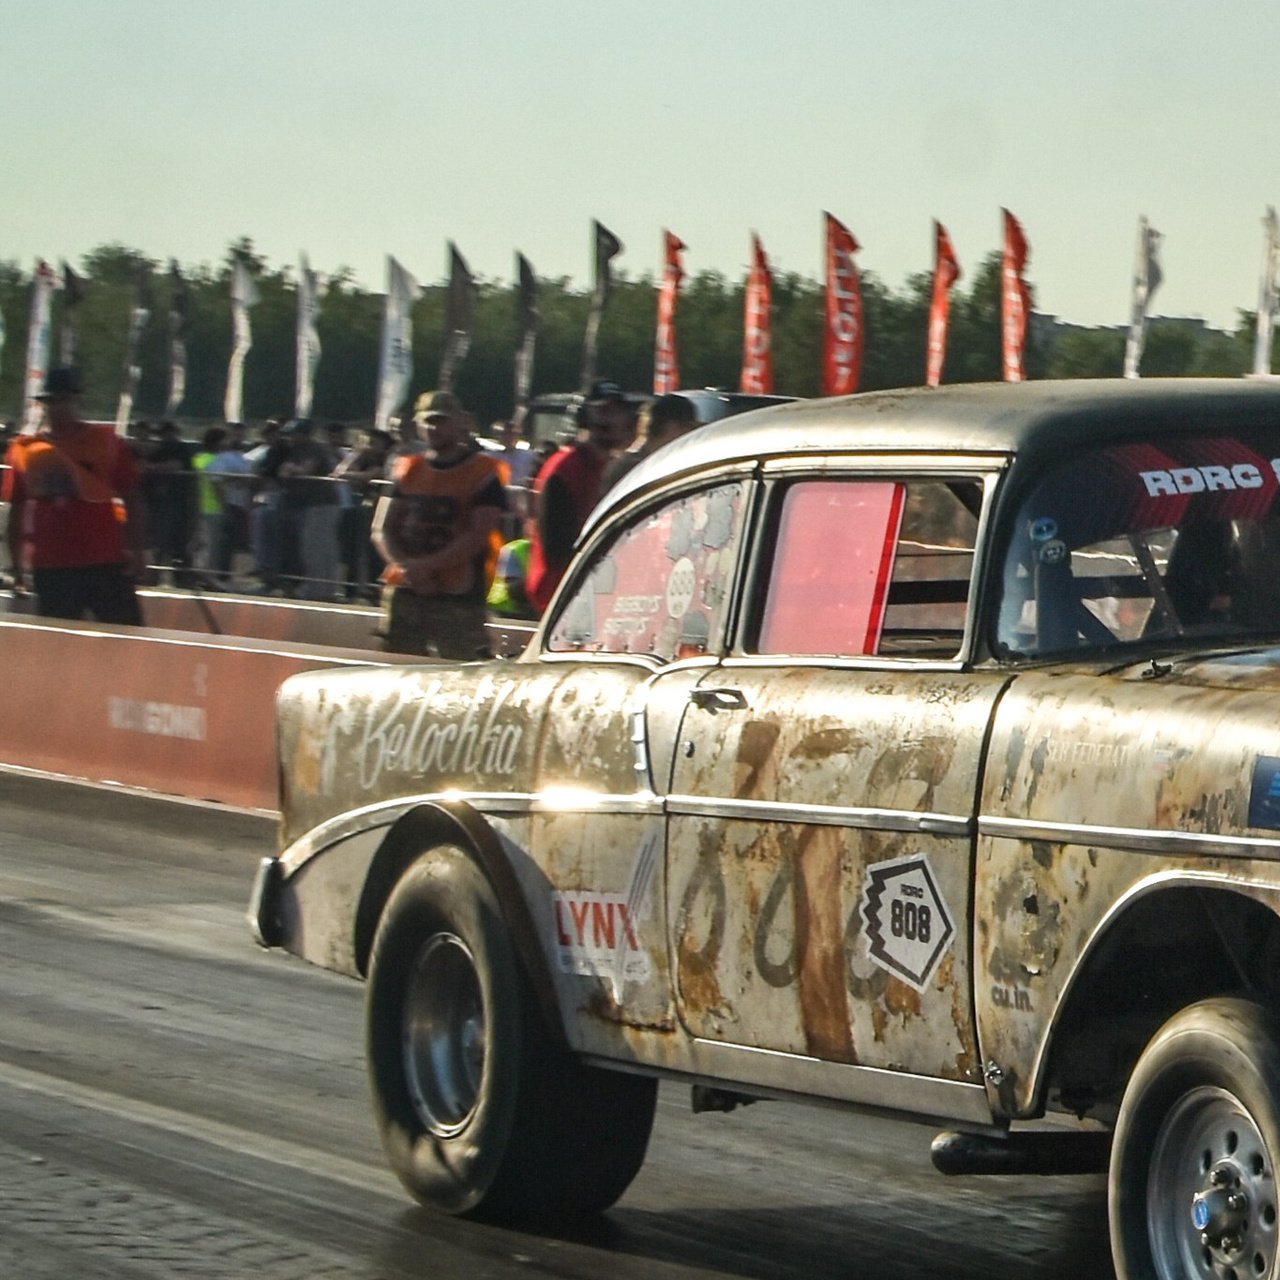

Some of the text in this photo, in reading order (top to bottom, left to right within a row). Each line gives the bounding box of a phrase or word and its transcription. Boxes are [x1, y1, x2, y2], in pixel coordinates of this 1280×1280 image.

[1139, 464, 1263, 497] RDRC
[359, 678, 522, 790] Belochka
[555, 900, 639, 951] LYNX
[891, 899, 931, 943] 808
